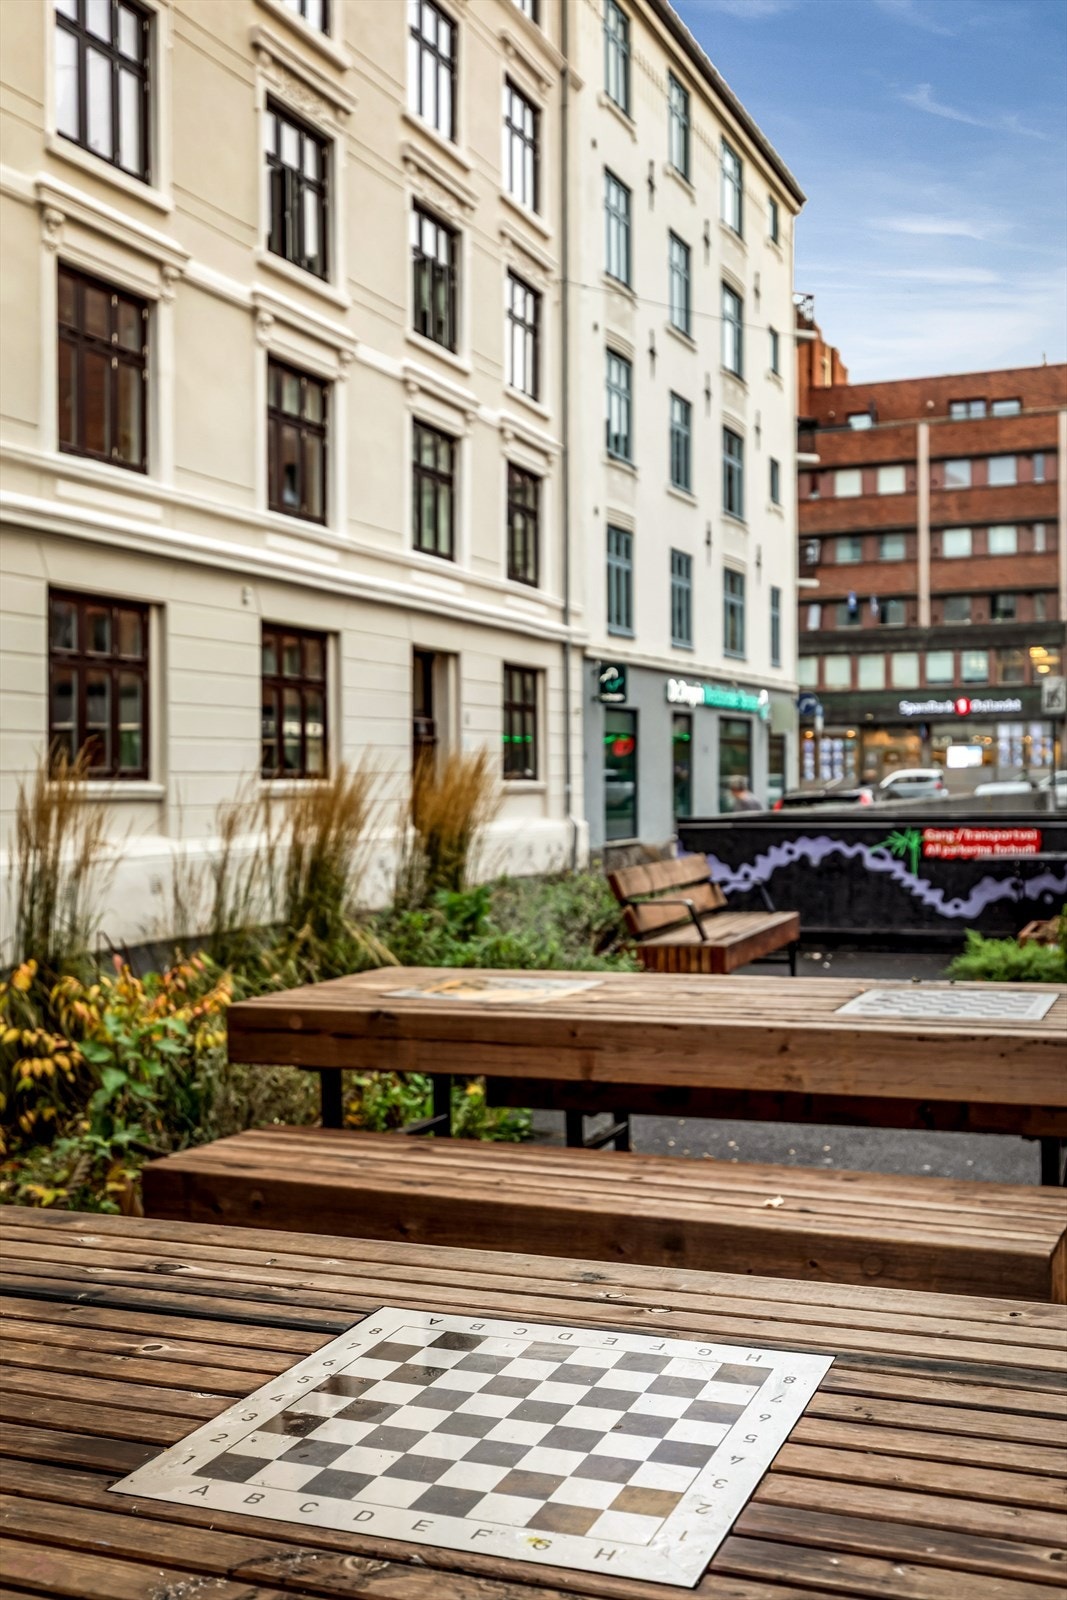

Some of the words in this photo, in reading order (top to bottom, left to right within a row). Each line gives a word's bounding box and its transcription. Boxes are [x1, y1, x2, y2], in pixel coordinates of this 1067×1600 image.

[347, 1342, 362, 1350] 7
[470, 1323, 485, 1331] B
[602, 1337, 618, 1345] E
[697, 1348, 712, 1356] G
[746, 1353, 762, 1362] H
[322, 1359, 336, 1367] 6
[297, 1375, 313, 1384] 5
[783, 1376, 797, 1384] 8
[269, 1394, 285, 1402] 4
[770, 1394, 783, 1402] 7
[241, 1412, 258, 1422] 3
[759, 1413, 772, 1422] 6
[209, 1433, 229, 1443] 2
[742, 1434, 756, 1443] 5
[182, 1455, 196, 1465] 1
[730, 1455, 744, 1465] 4
[712, 1478, 728, 1489] 3
[695, 1503, 713, 1514] 2
[189, 1485, 210, 1496] A
[243, 1492, 266, 1504] B
[299, 1502, 320, 1513] C
[353, 1510, 375, 1522] D
[411, 1519, 434, 1532] E
[470, 1528, 493, 1540] F
[532, 1538, 553, 1550] G
[594, 1547, 617, 1561] H
[678, 1530, 688, 1541] 1
